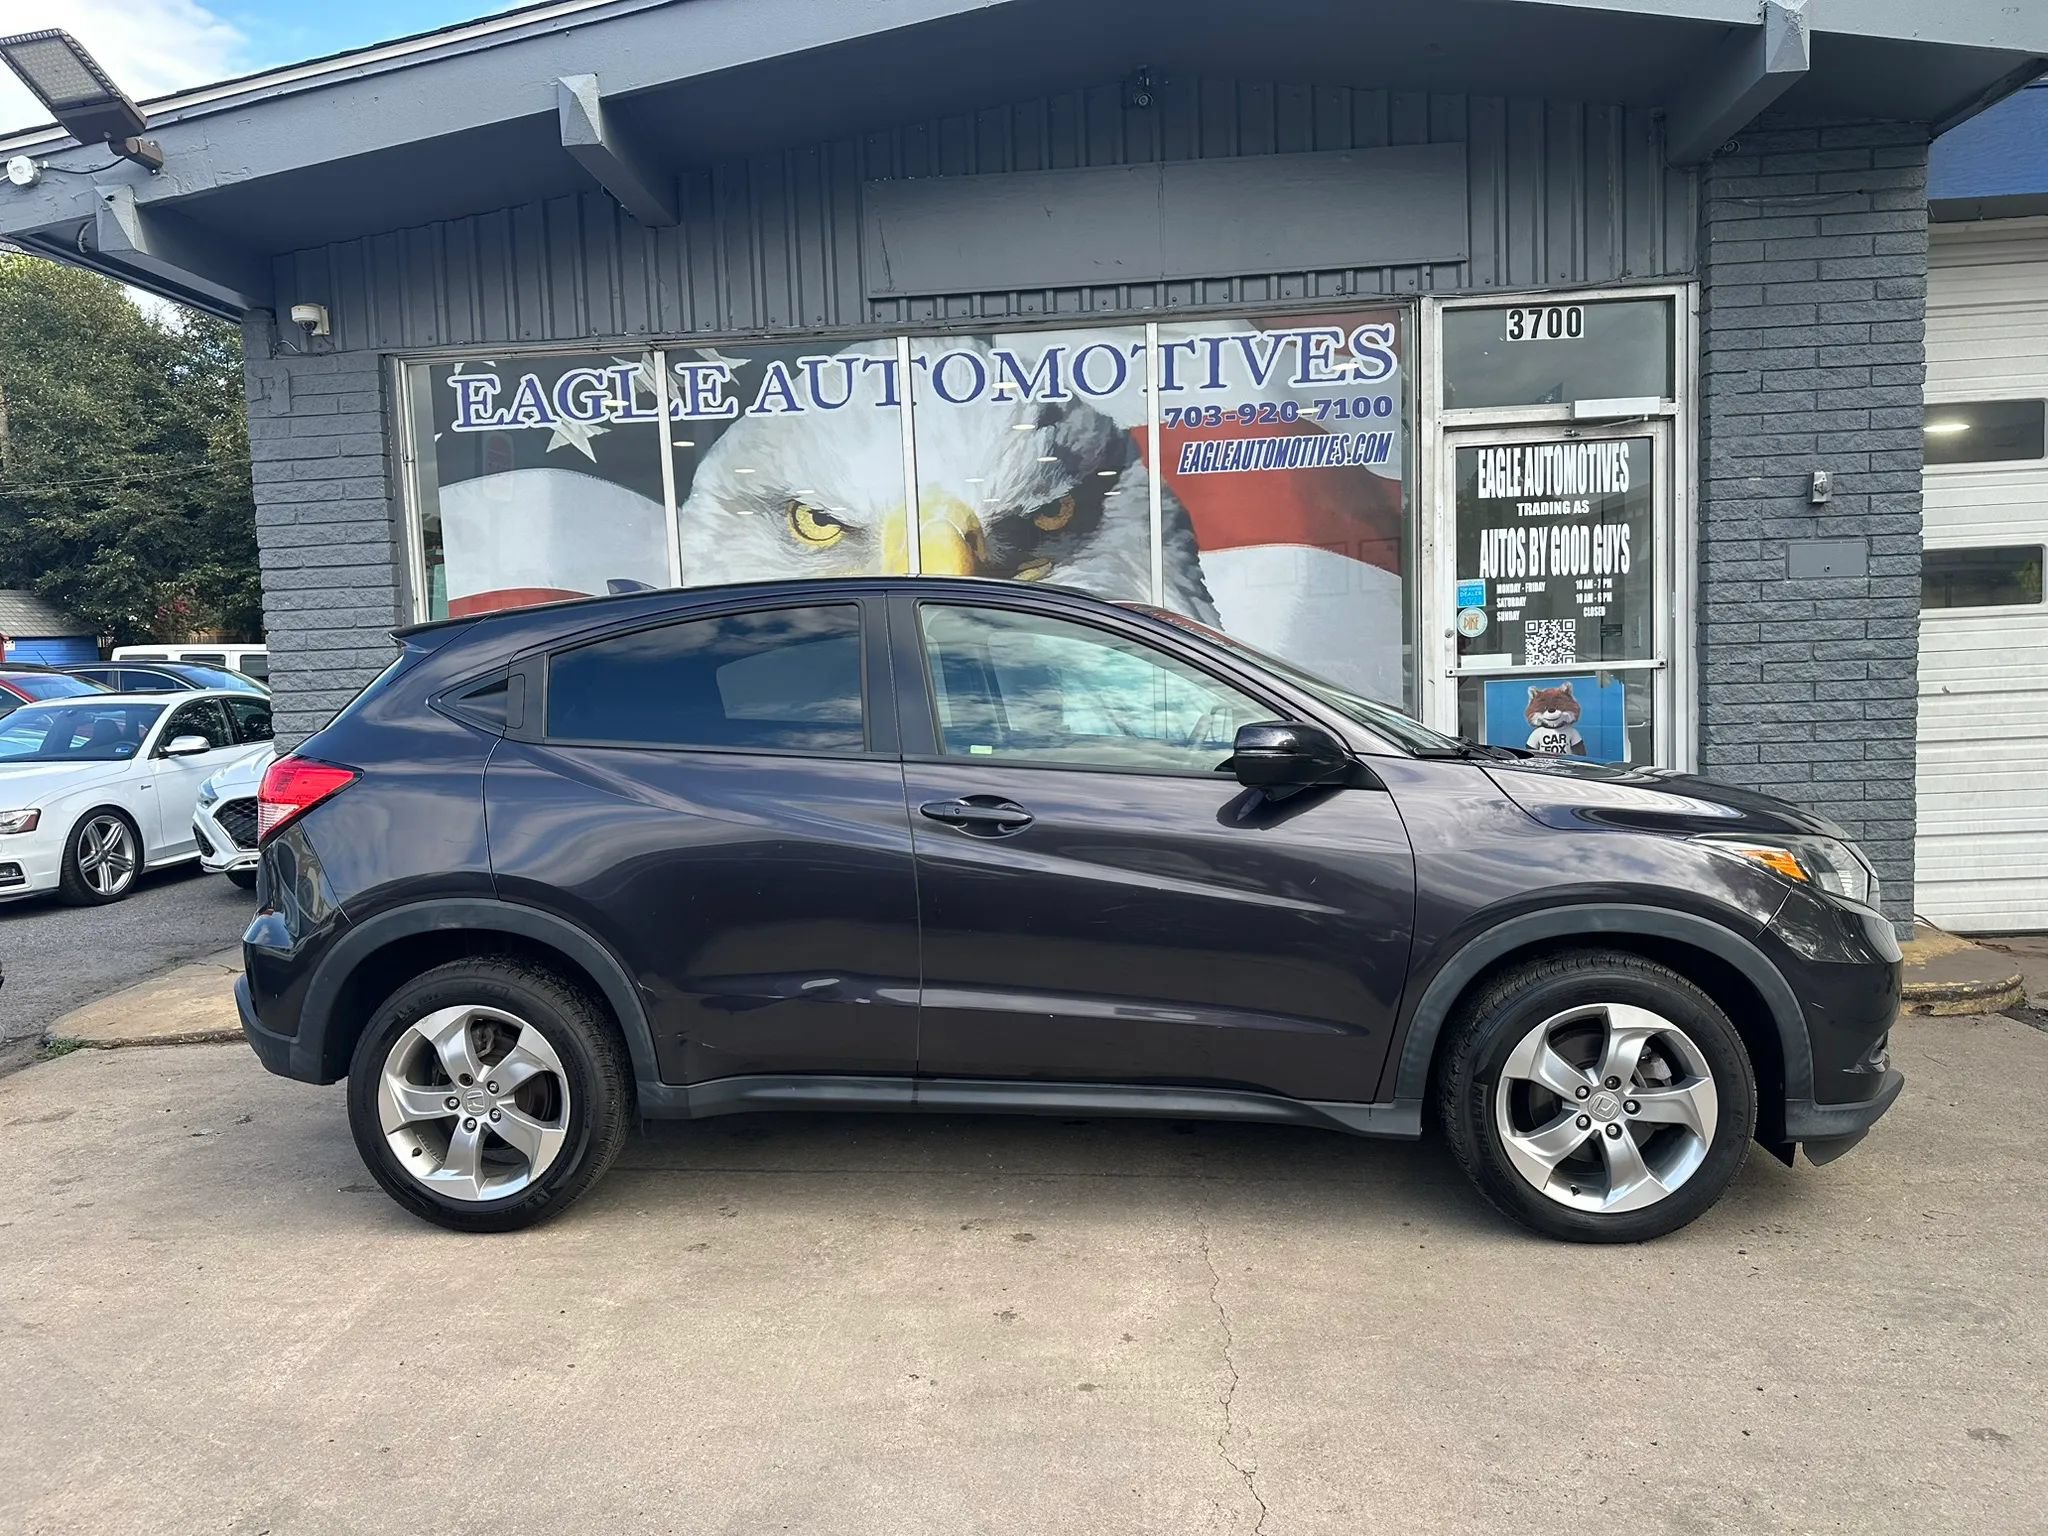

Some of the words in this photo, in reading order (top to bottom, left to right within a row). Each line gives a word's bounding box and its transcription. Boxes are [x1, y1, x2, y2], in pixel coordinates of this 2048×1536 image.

[1508, 307, 1582, 340] 3700
[451, 360, 738, 431] EAGLE
[747, 324, 1396, 417] AUTOMOTIVES
[1165, 396, 1393, 429] 703-920-7100
[1178, 432, 1394, 474] EAGLEAUTOMOTIVES.COM
[1478, 448, 1521, 498] EAGLE
[1524, 442, 1630, 497] AUTOMOTIVES
[1517, 502, 1570, 516] TRADING
[1573, 500, 1590, 514] AS
[1479, 527, 1526, 579] AUTOS
[1529, 527, 1548, 577] BY
[1551, 525, 1590, 576] GOOD
[1593, 523, 1630, 575] GUYS
[1496, 583, 1521, 594] MONDAY
[1525, 581, 1546, 592] FRIDAY
[1496, 596, 1526, 608] SATURDAY
[1583, 605, 1606, 617] CLOSED
[1496, 610, 1520, 622] SUNDAY
[1542, 734, 1567, 745] CAR
